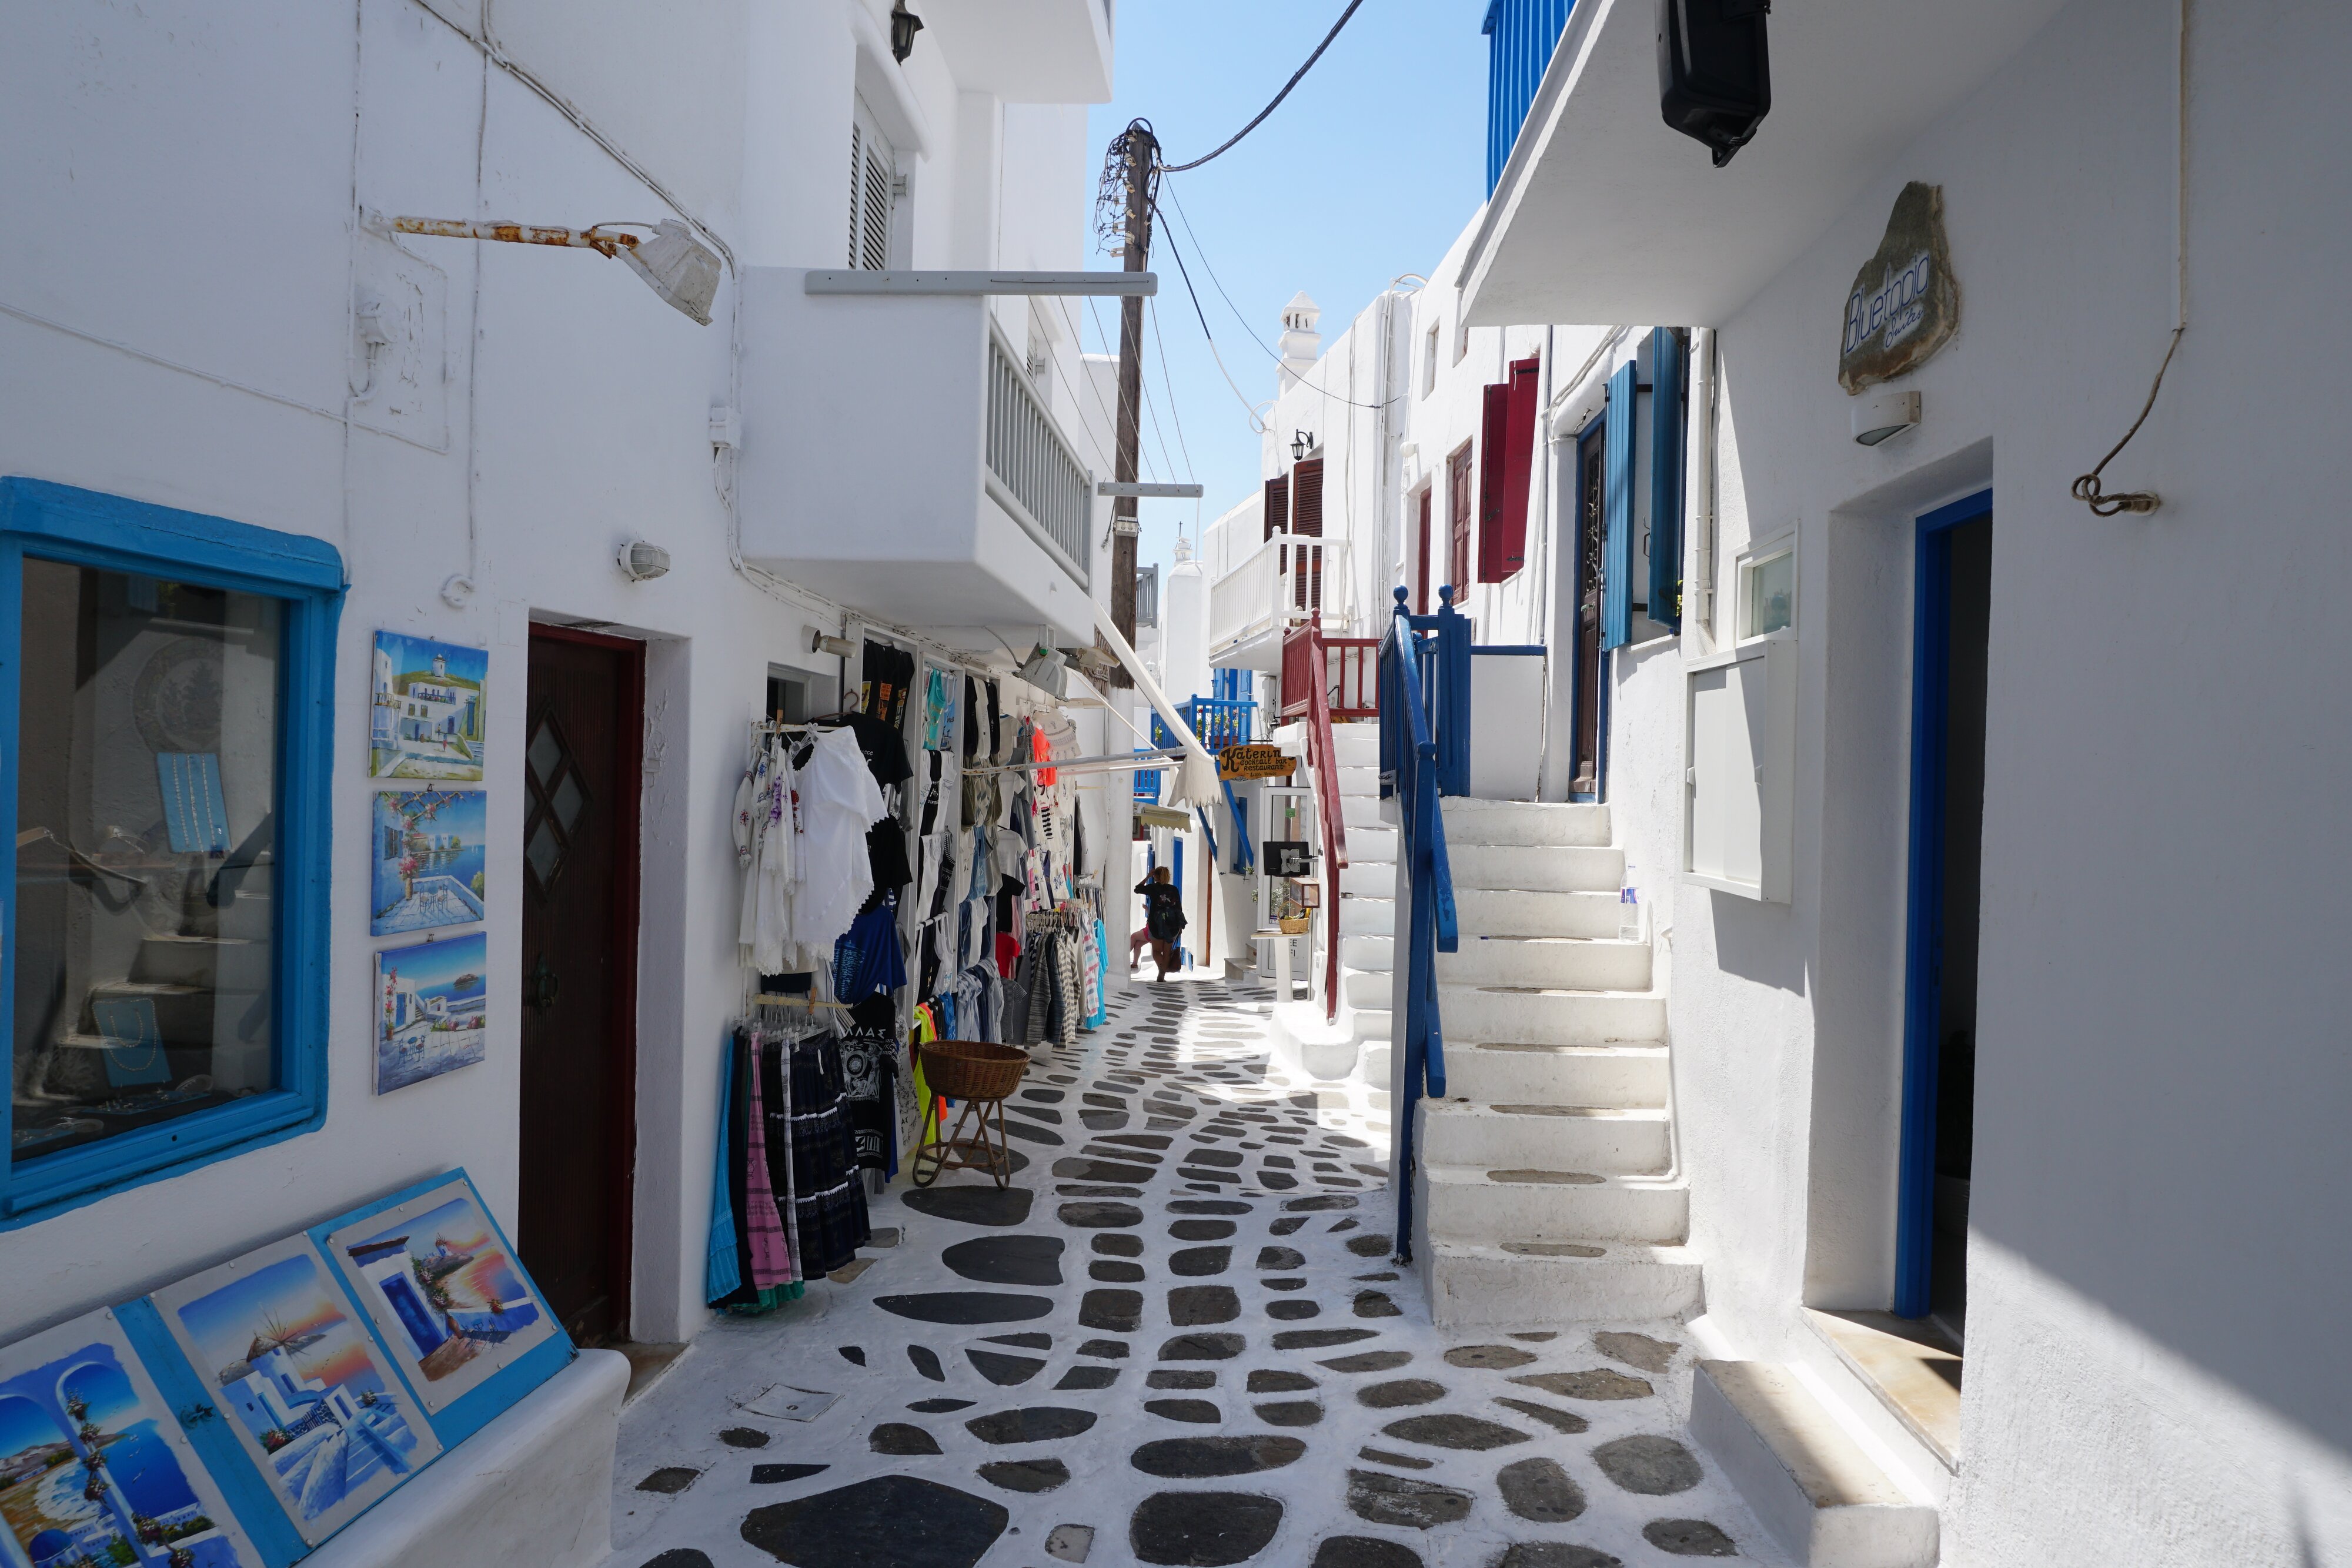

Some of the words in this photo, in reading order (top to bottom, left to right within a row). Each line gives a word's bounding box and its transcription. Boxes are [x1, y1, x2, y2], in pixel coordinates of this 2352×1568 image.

[1846, 254, 1929, 353] Bluetopia
[1885, 307, 1923, 348] Suites
[1221, 747, 1295, 773] Katerin
